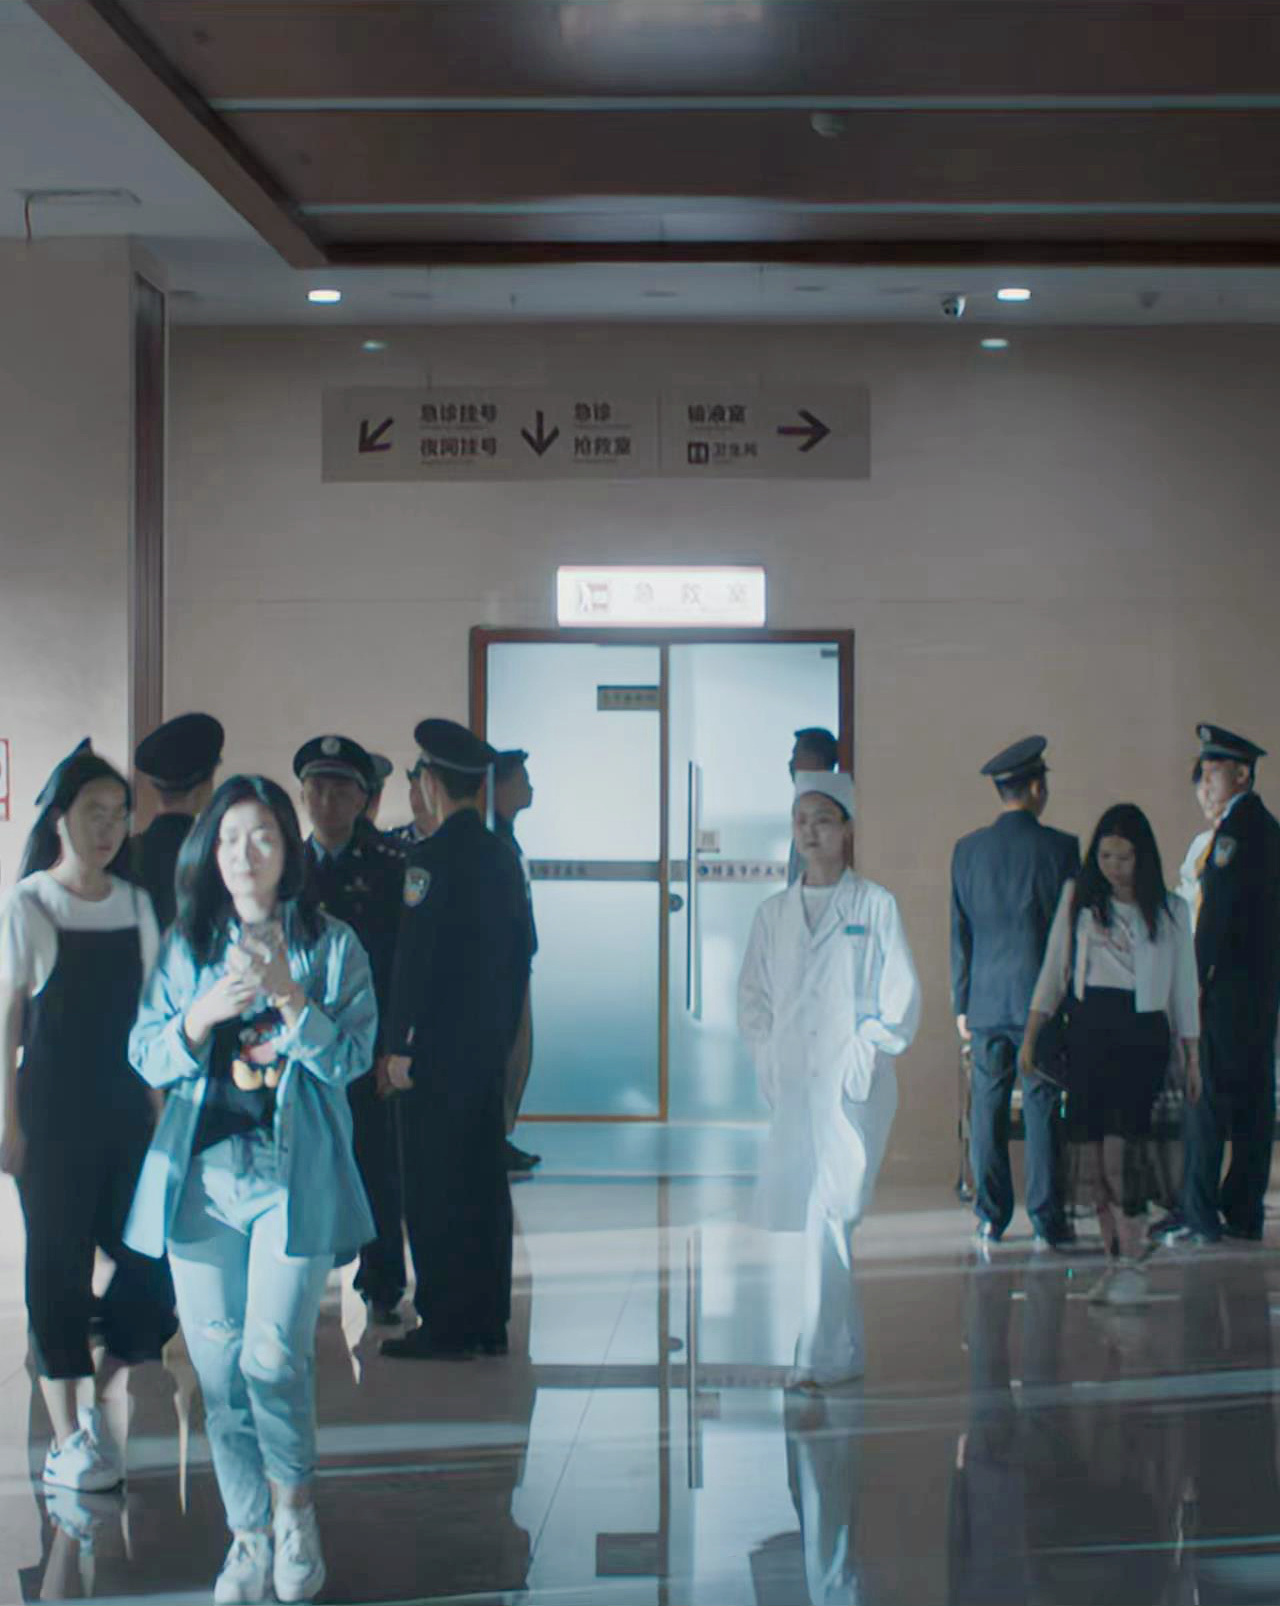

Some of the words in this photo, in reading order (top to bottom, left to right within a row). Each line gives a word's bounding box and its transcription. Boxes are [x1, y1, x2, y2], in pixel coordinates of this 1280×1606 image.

[420, 403, 497, 422] 急诊挂号
[574, 403, 611, 421] 急诊
